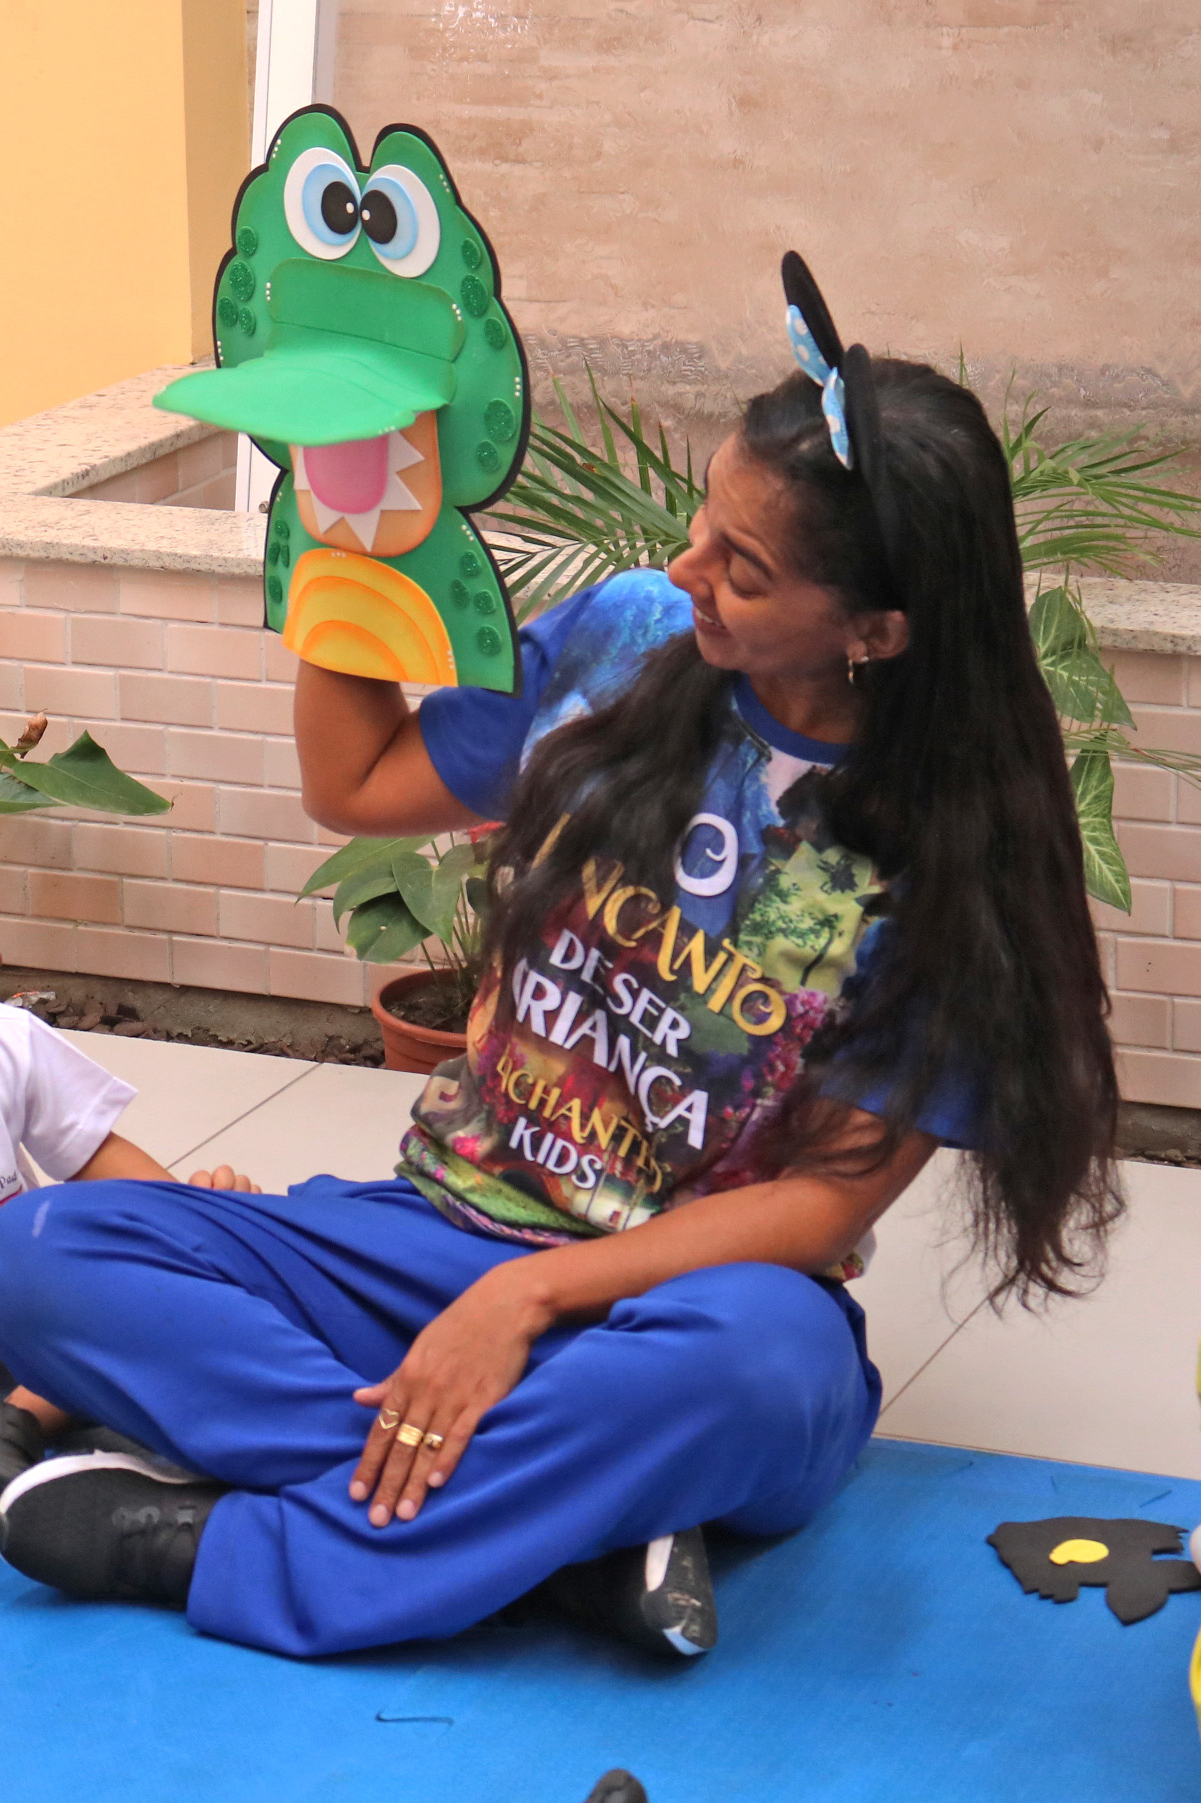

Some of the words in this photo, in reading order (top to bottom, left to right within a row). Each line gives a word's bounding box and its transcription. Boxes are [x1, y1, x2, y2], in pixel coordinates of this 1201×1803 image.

[674, 812, 738, 897] O
[606, 972, 692, 1058] SER
[509, 1116, 603, 1190] KIDS
